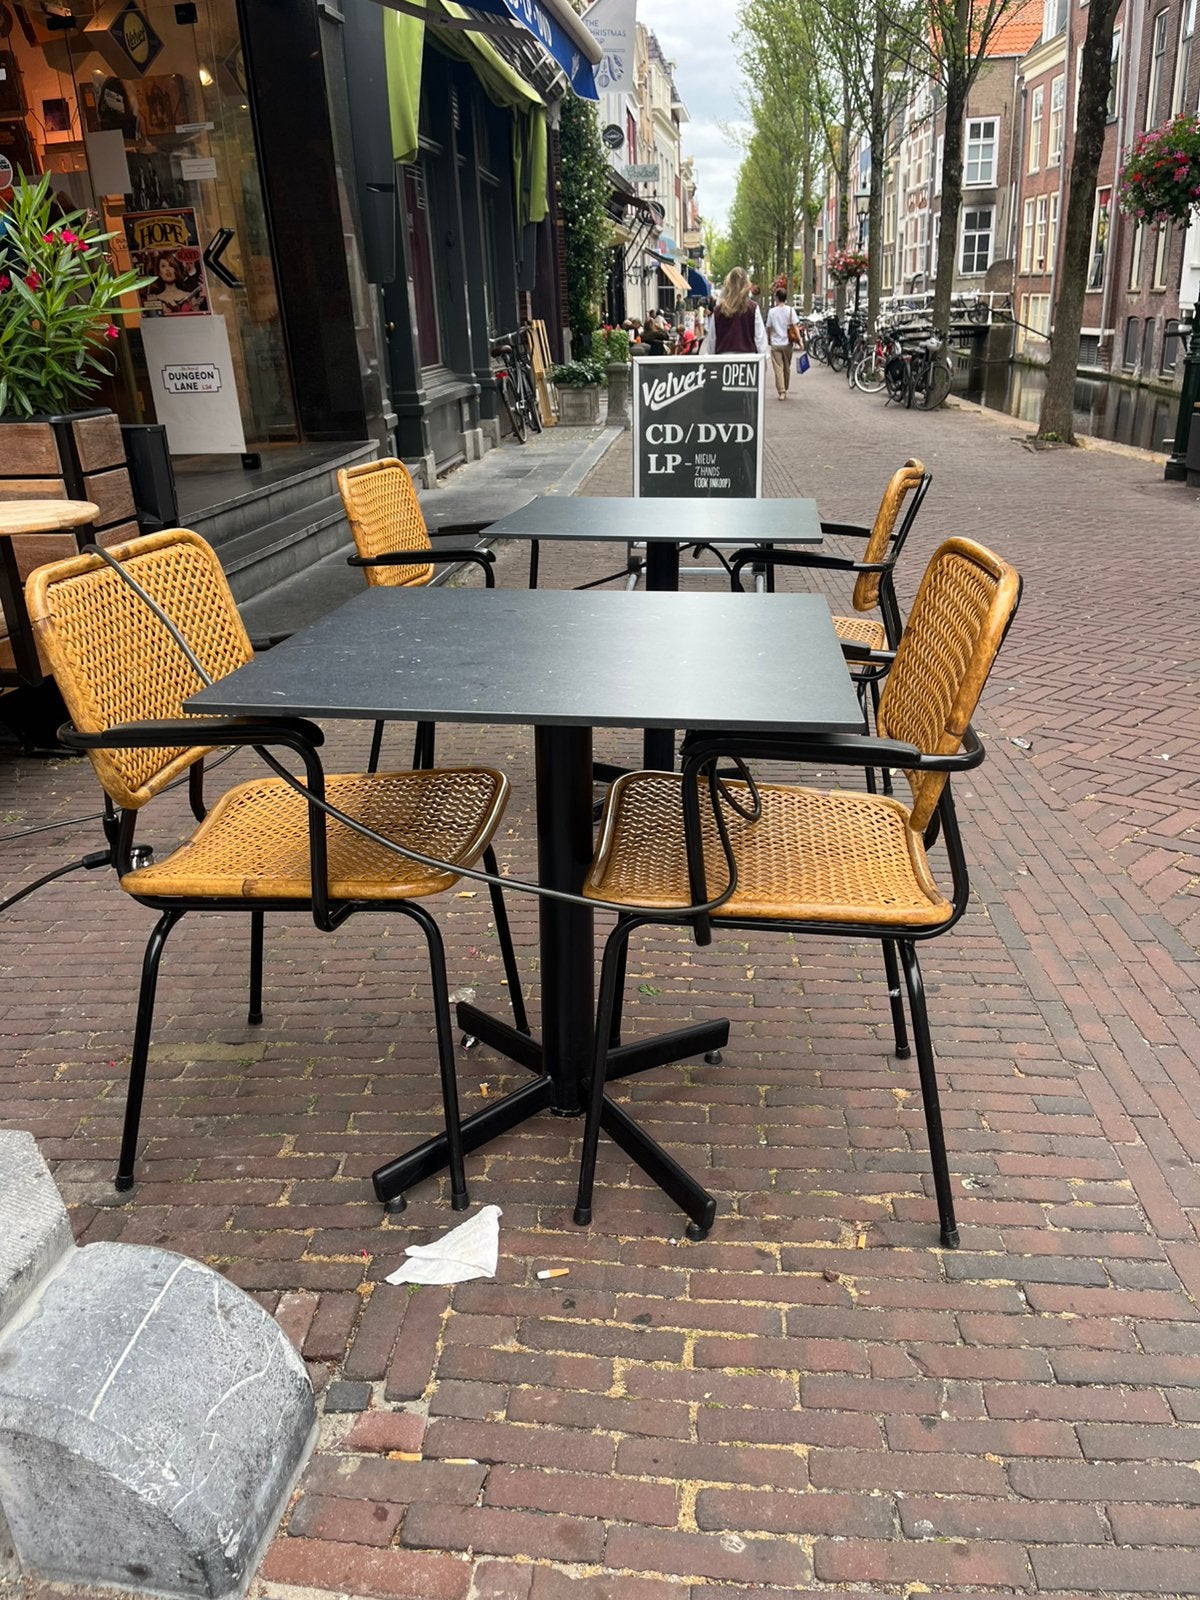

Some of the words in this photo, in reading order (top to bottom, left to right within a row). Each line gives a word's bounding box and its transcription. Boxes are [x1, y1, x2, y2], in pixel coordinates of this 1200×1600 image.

[586, 19, 598, 27] THE
[591, 29, 626, 37] HRISTMAS
[140, 223, 188, 247] HOPE
[168, 371, 214, 381] DUNGEON
[174, 382, 199, 391] LANE
[642, 364, 706, 411] Velvet
[722, 363, 757, 386] OPEN
[647, 453, 682, 474] LP
[694, 453, 717, 465] NIEUW
[694, 477, 709, 489] (OOK
